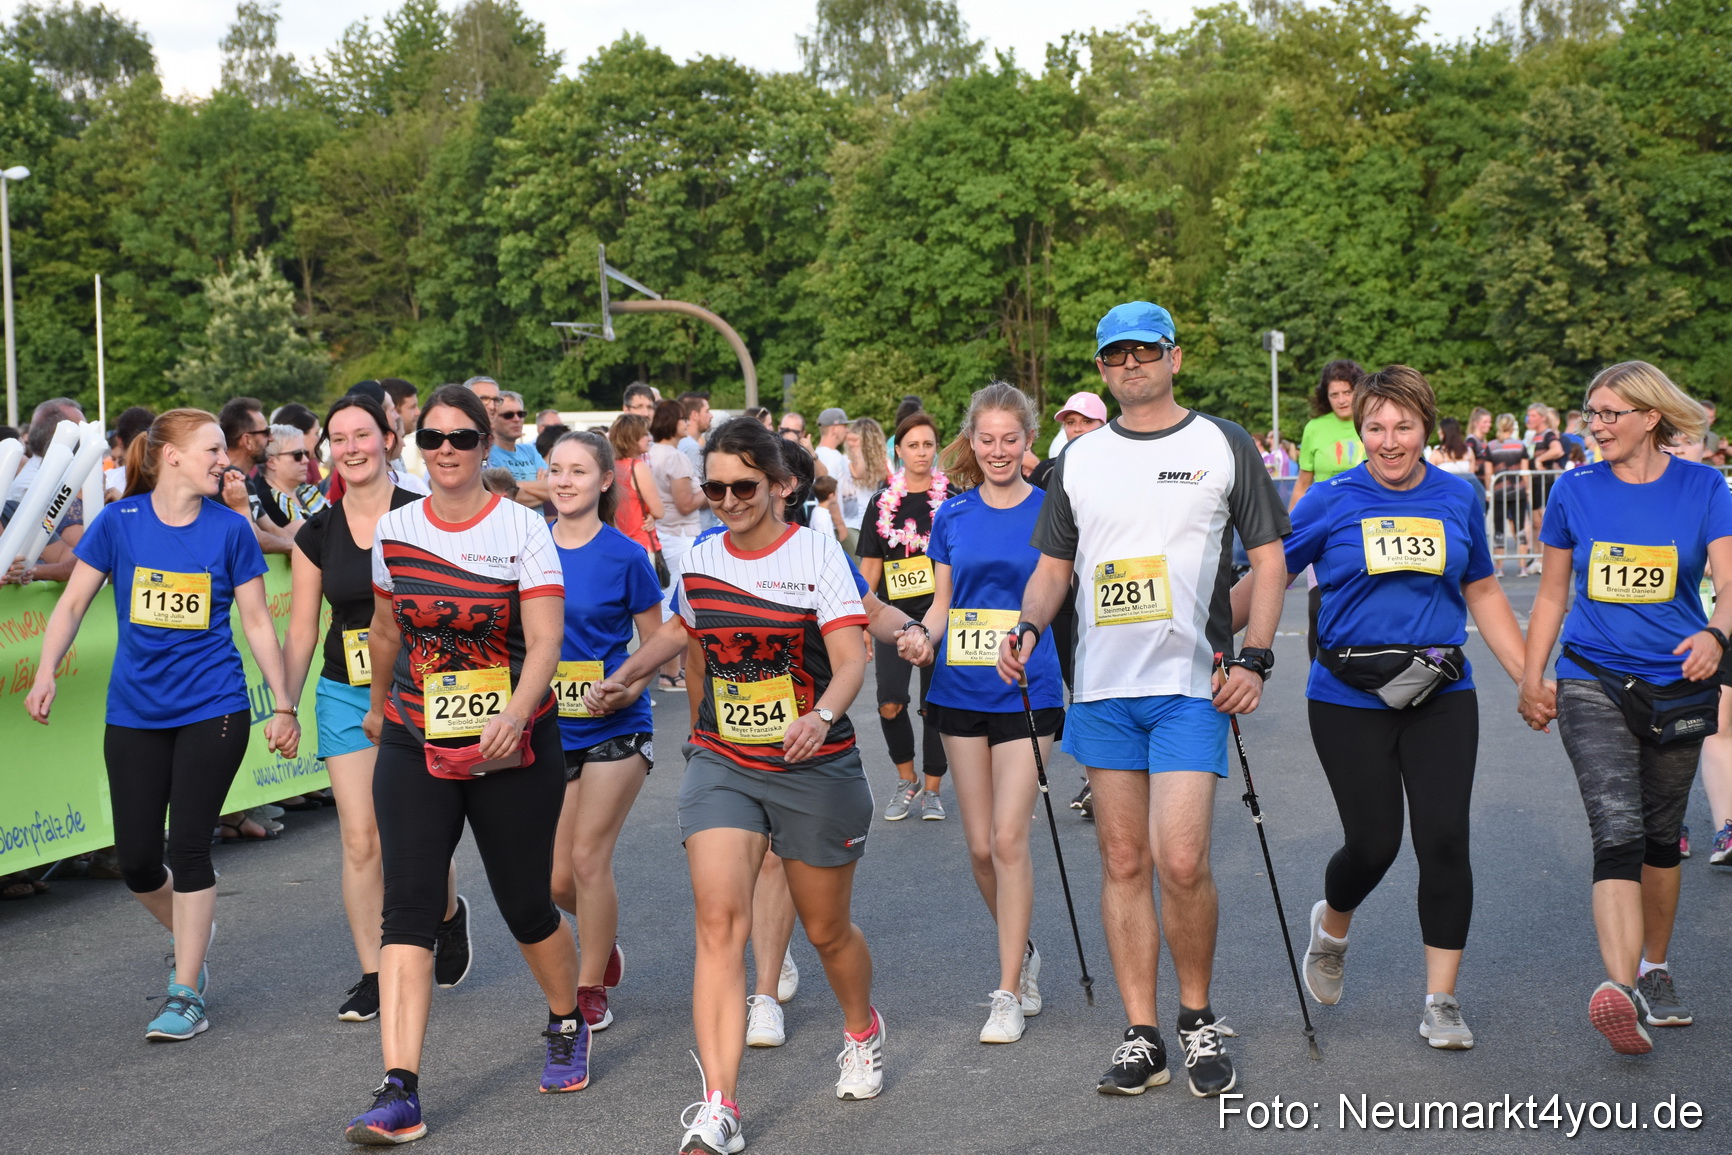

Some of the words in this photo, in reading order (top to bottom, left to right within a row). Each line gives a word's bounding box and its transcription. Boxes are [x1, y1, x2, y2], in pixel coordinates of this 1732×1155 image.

[1158, 471, 1191, 481] swn
[46, 484, 73, 520] swn
[1375, 536, 1436, 557] 1133
[461, 553, 509, 563] NEUMARKT
[756, 581, 806, 591] NEUMARKT
[891, 570, 927, 588] 1962
[1600, 565, 1664, 588] 1129
[142, 589, 200, 613] 1136
[1100, 578, 1156, 607] 2281
[1103, 606, 1131, 614] Steinmetz
[435, 692, 501, 720] 2262
[723, 700, 787, 726] 2254
[447, 718, 474, 726] Seibold
[750, 725, 783, 733] Franziska
